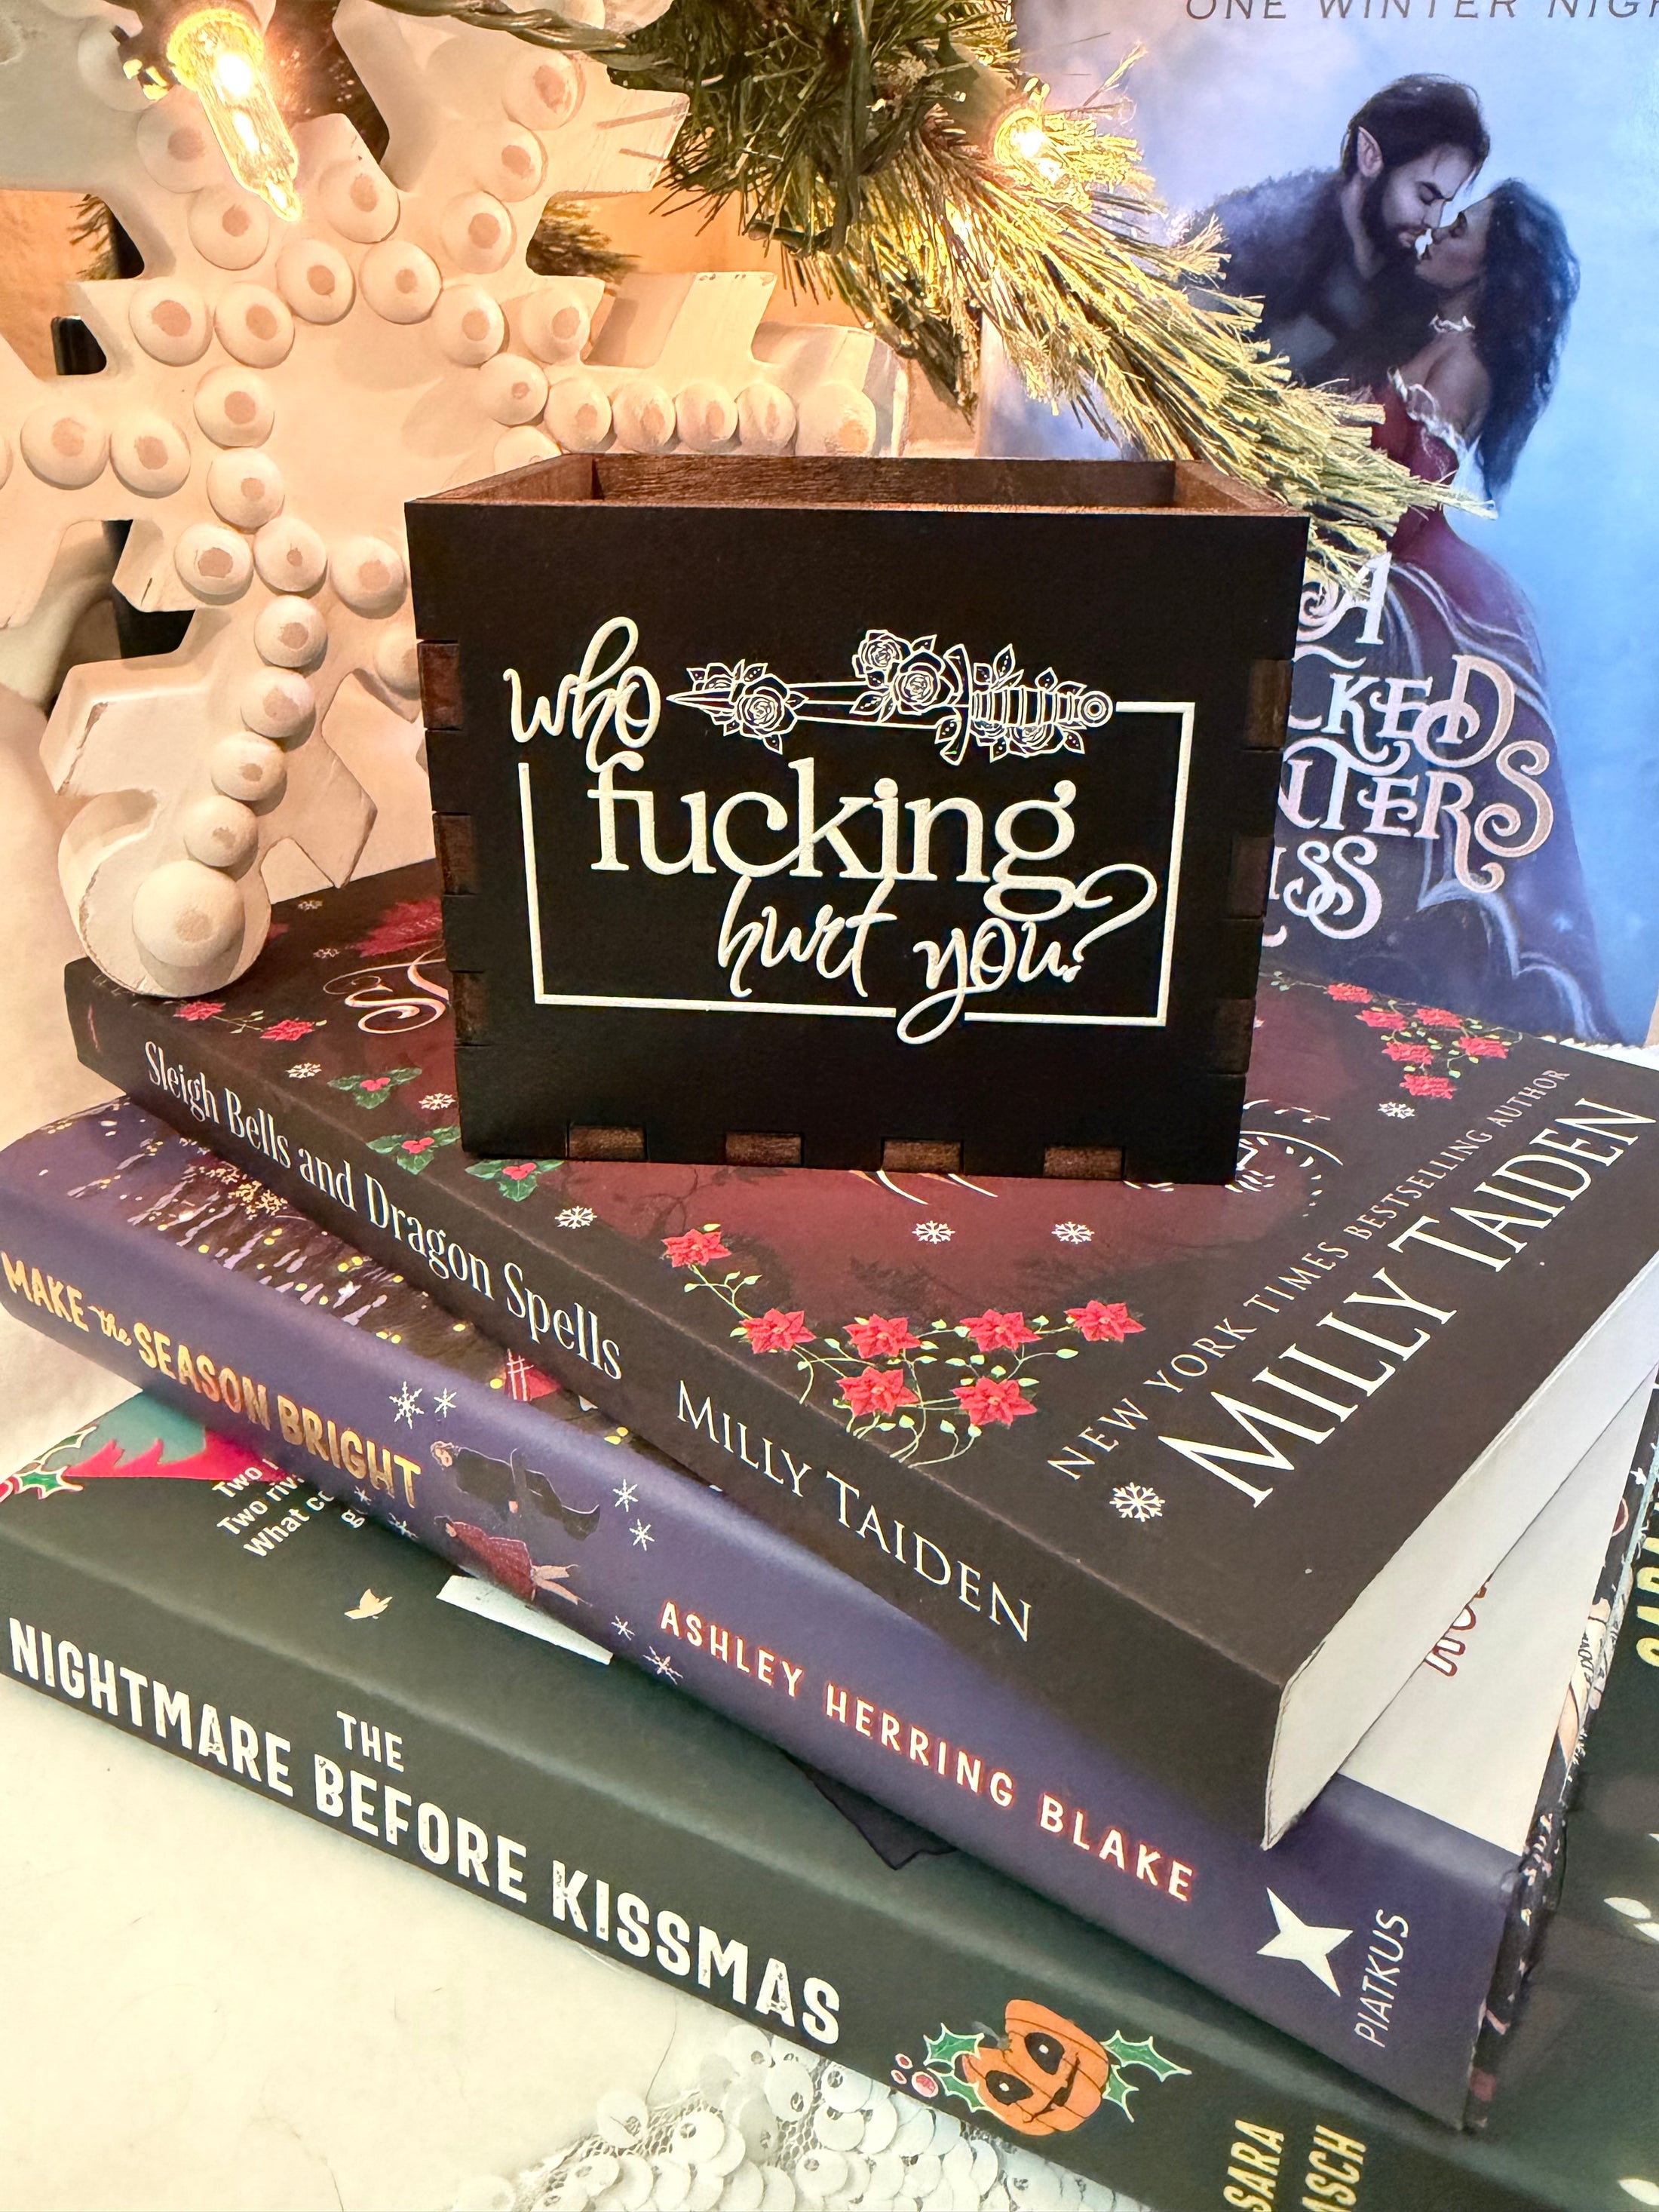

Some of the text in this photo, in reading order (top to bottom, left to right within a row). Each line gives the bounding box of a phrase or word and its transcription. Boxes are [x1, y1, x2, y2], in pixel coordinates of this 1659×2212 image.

[1185, 0, 1286, 20] ONE
[503, 616, 661, 772] who
[587, 751, 1077, 922] fucking
[718, 864, 1158, 1045] hurt you?
[144, 1040, 623, 1381] Sleigh Bells and Dragon Spells
[1046, 1068, 1571, 1481] NEW YORK TIMES BESTSELLING AUTHOR
[1, 1250, 422, 1509] MAKE the SEASON BRIGHT
[1158, 1097, 1657, 1509] MILLY TAIDEN
[211, 1466, 264, 1499] Two
[216, 1499, 269, 1536] Two
[243, 1507, 311, 1557] What
[676, 1379, 1032, 1643] MILLY TAIDEN
[336, 1710, 405, 1772] THE
[658, 1600, 1194, 1904] ASHLEY HERRING BLAKE
[8, 1617, 841, 2045] NIGHTMARE BEFORE KISSMAS
[1354, 1909, 1409, 2048] PIATKUS
[1222, 2119, 1285, 2212] SARA
